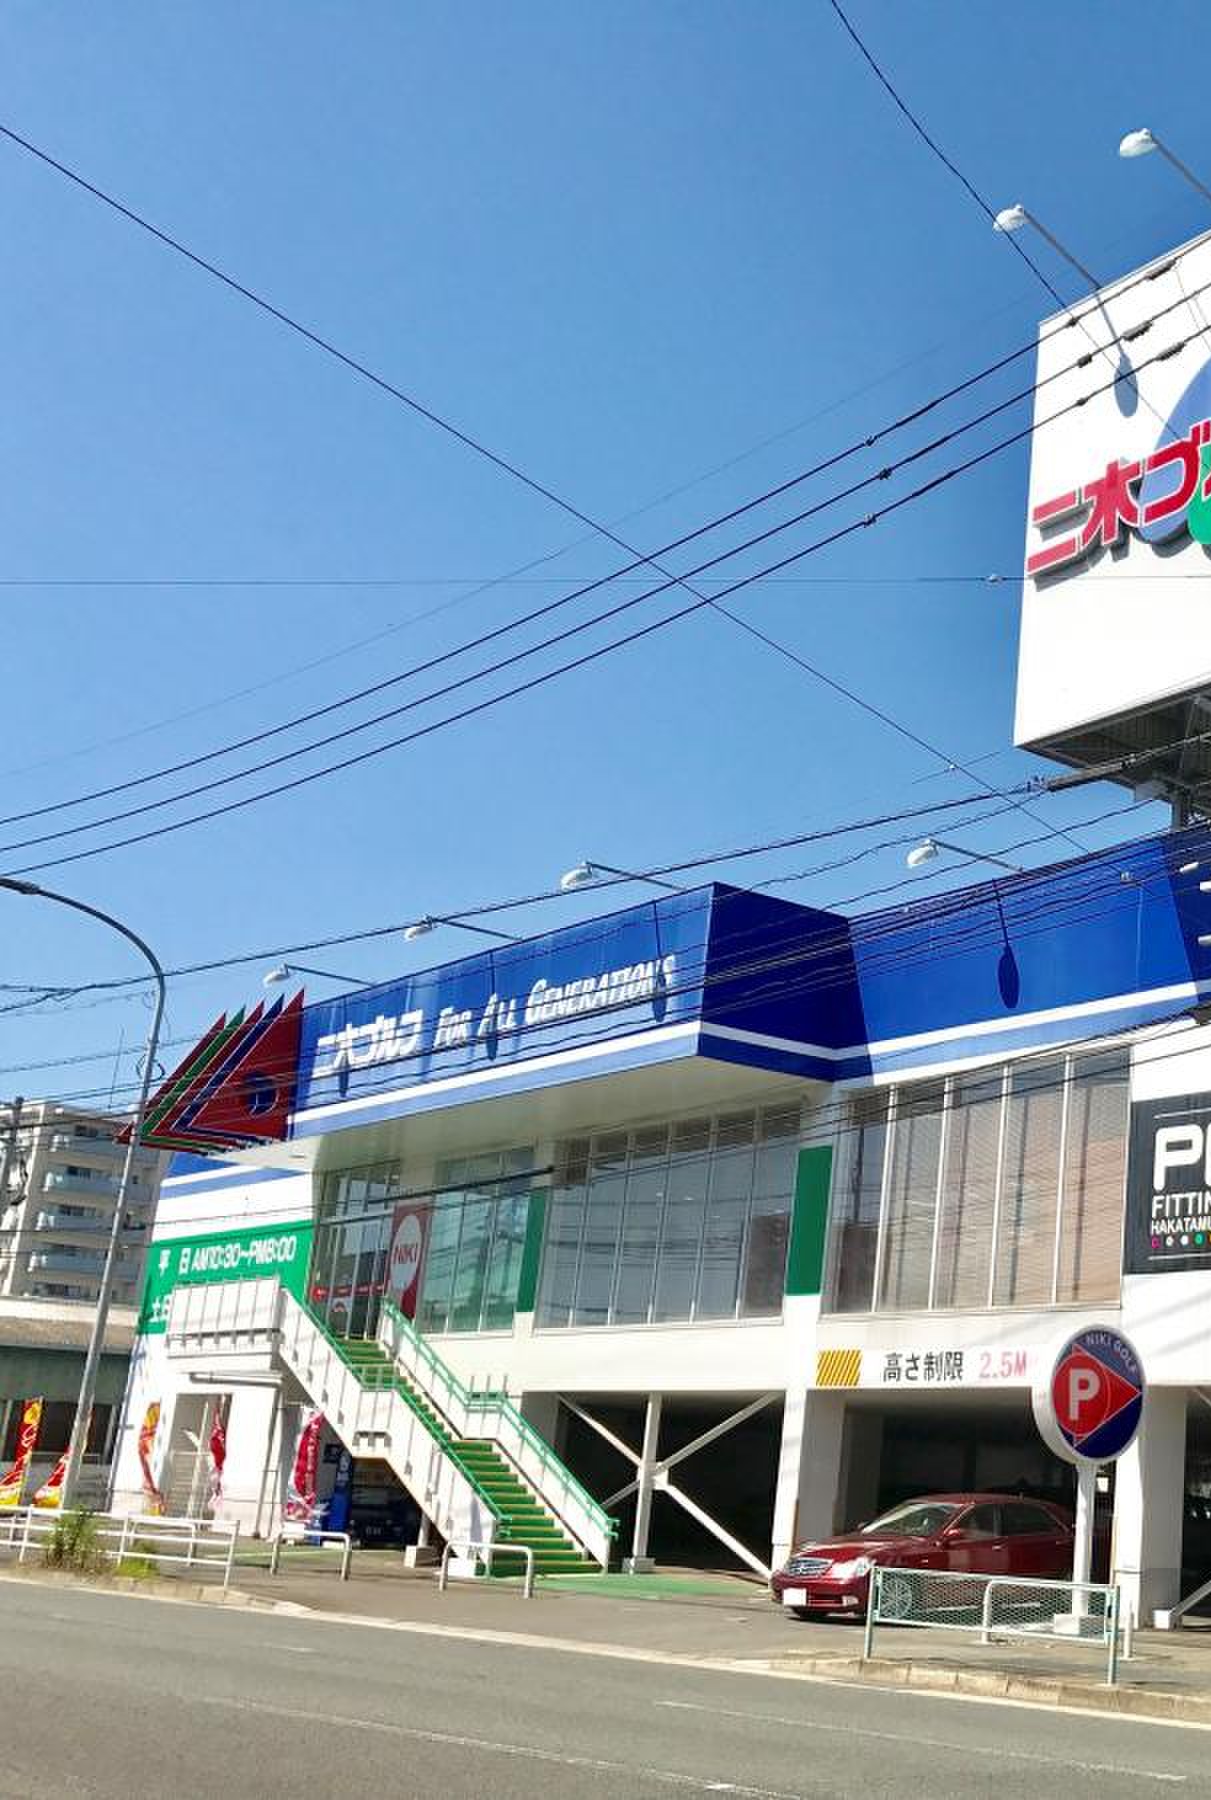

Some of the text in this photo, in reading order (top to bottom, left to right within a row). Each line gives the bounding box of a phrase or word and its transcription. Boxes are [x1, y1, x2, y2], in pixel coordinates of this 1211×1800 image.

[1086, 1332, 1111, 1345] NIKI
[882, 1352, 1028, 1382] 高さ制限 2.5M
[1068, 1368, 1100, 1421] P
